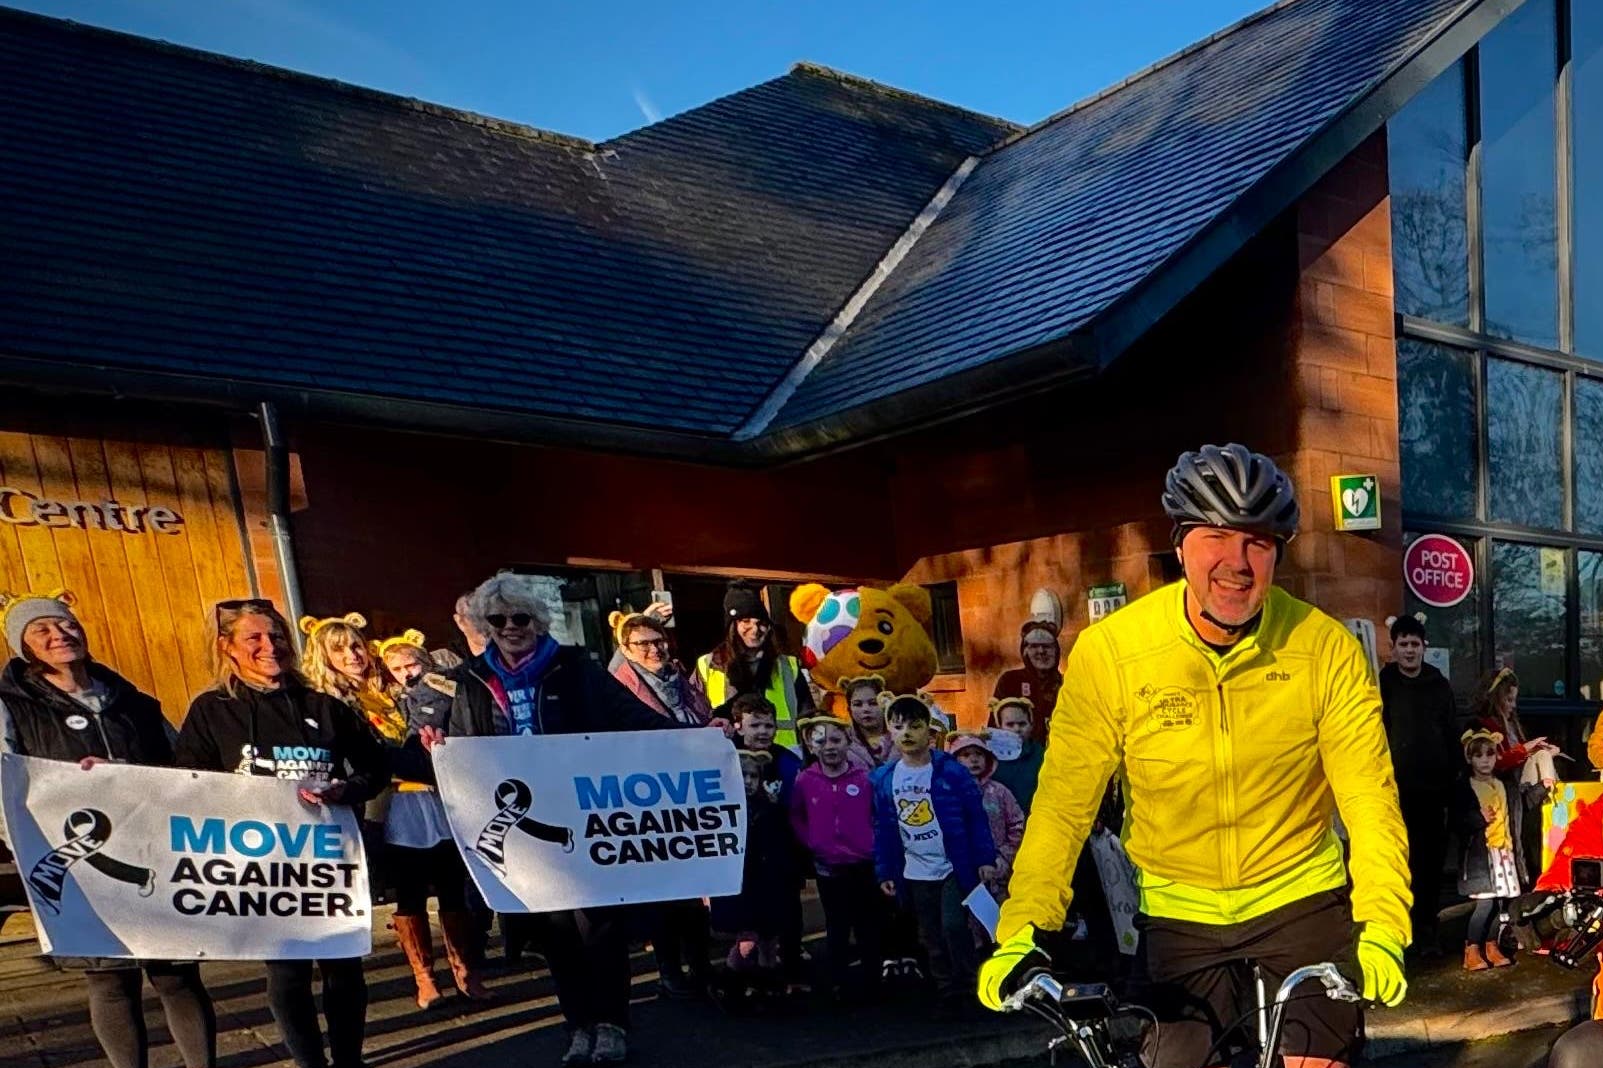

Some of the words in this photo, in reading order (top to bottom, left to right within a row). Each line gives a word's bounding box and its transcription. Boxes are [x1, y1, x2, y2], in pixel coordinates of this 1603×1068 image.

[0, 486, 184, 535] Centre
[1421, 549, 1459, 570] POST
[1412, 567, 1464, 589] OFFICE
[1021, 682, 1031, 697] B
[1265, 670, 1291, 681] dhb
[272, 746, 331, 761] MOVE
[276, 760, 334, 772] AGAINST
[573, 769, 726, 811] MOVE
[484, 803, 529, 857] MOVE
[584, 804, 741, 839] AGAINST
[913, 829, 939, 841] NEED
[169, 815, 346, 860] MOVE
[589, 832, 744, 866] CANCER.
[37, 834, 105, 883] MOVE
[170, 857, 360, 888] AGAINST
[172, 889, 366, 917] CANCER.
